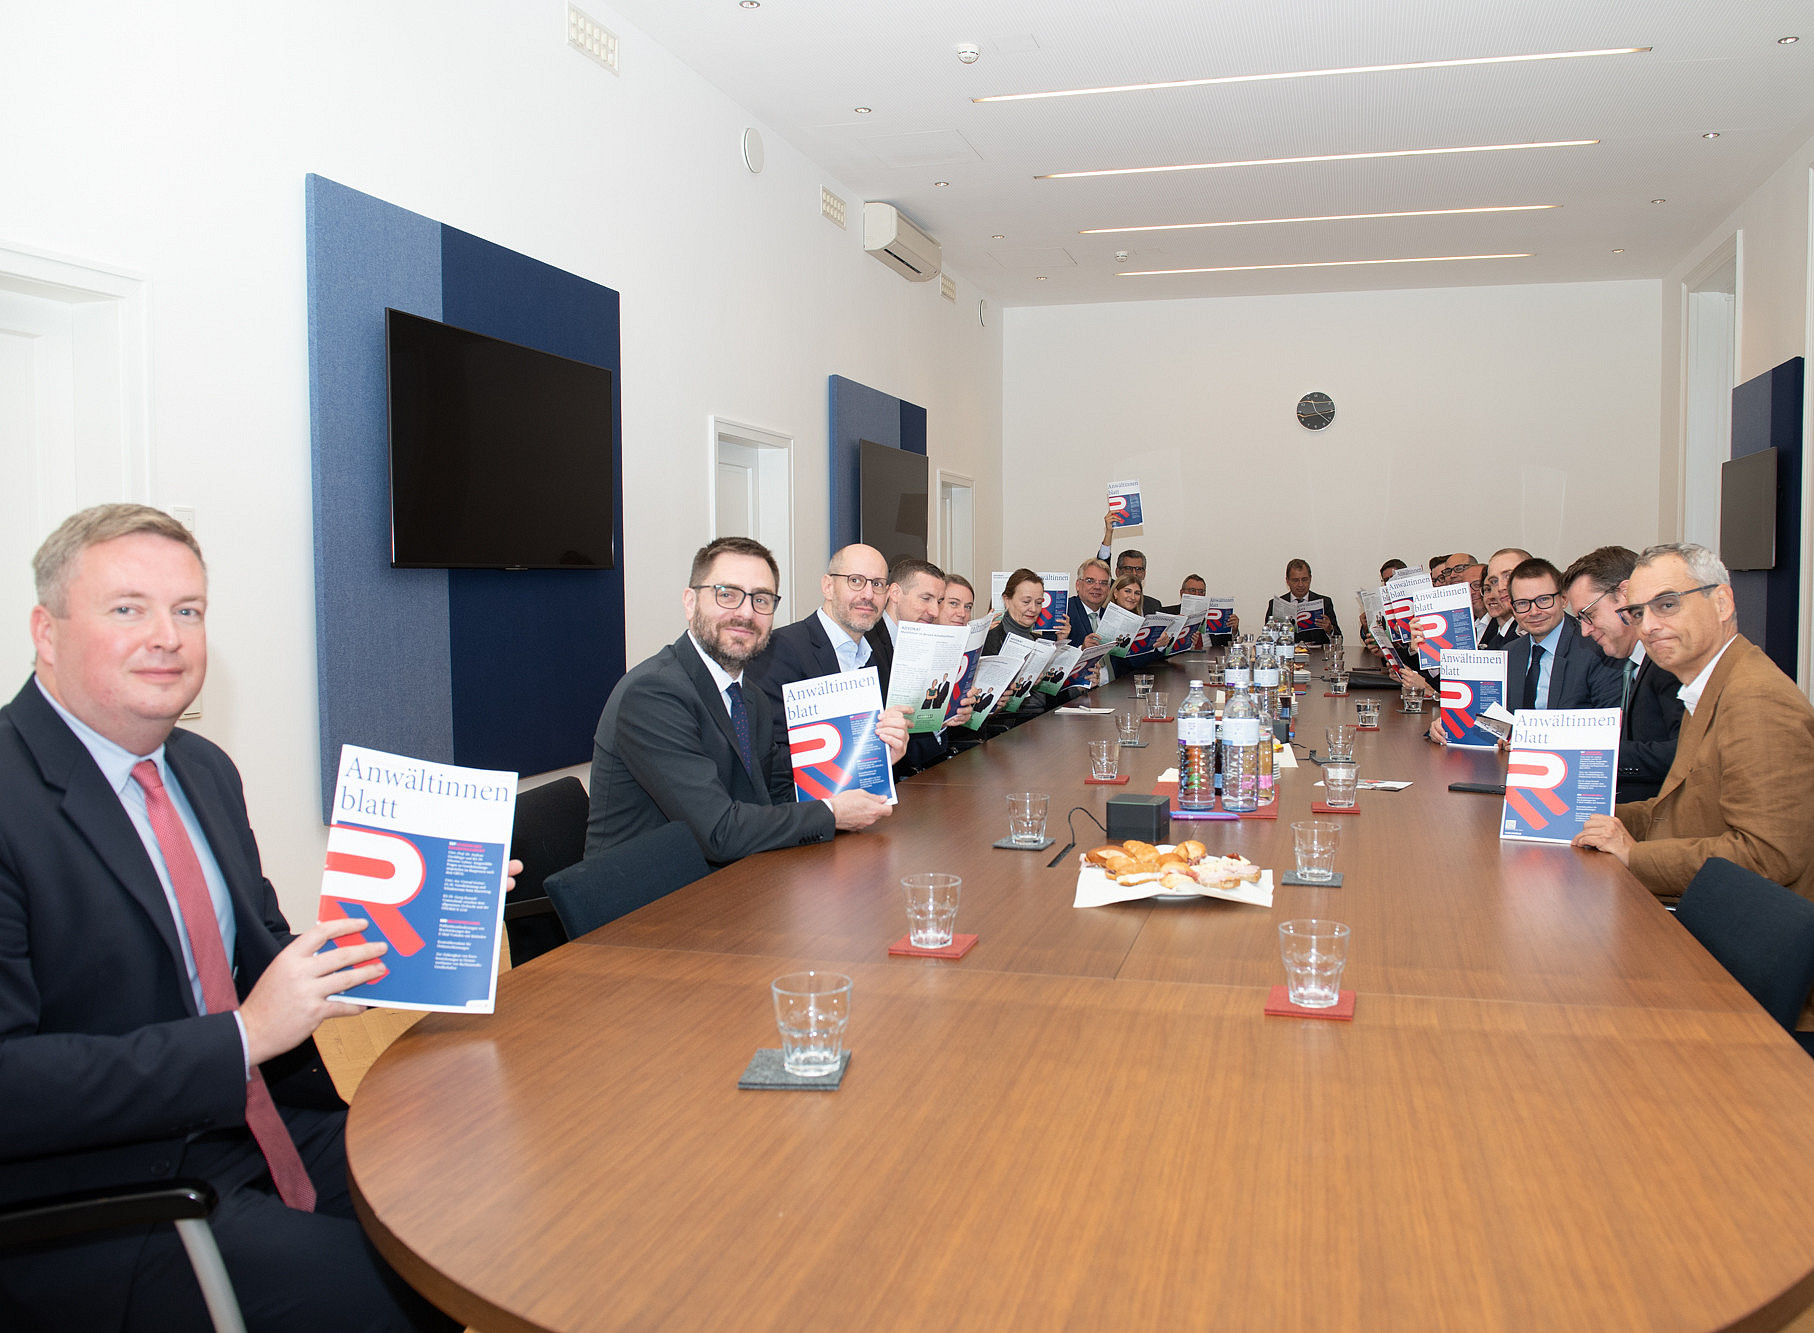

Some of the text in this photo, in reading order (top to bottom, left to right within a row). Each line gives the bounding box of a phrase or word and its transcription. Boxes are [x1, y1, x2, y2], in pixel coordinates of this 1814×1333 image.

[1389, 577, 1431, 590] Anwältinnen
[1390, 590, 1405, 598] blatt
[1414, 587, 1468, 602] Anwältinnen
[1414, 603, 1433, 612] blatt
[1440, 653, 1502, 665] Anwältinnen
[1440, 665, 1460, 675] blatt
[786, 675, 876, 703] Anwältinnen
[787, 704, 819, 720] blatt
[1516, 714, 1616, 728] Anwältinnen
[1514, 730, 1549, 744] blatt
[344, 757, 509, 802] Anwältinnen
[341, 786, 398, 819] blatt
